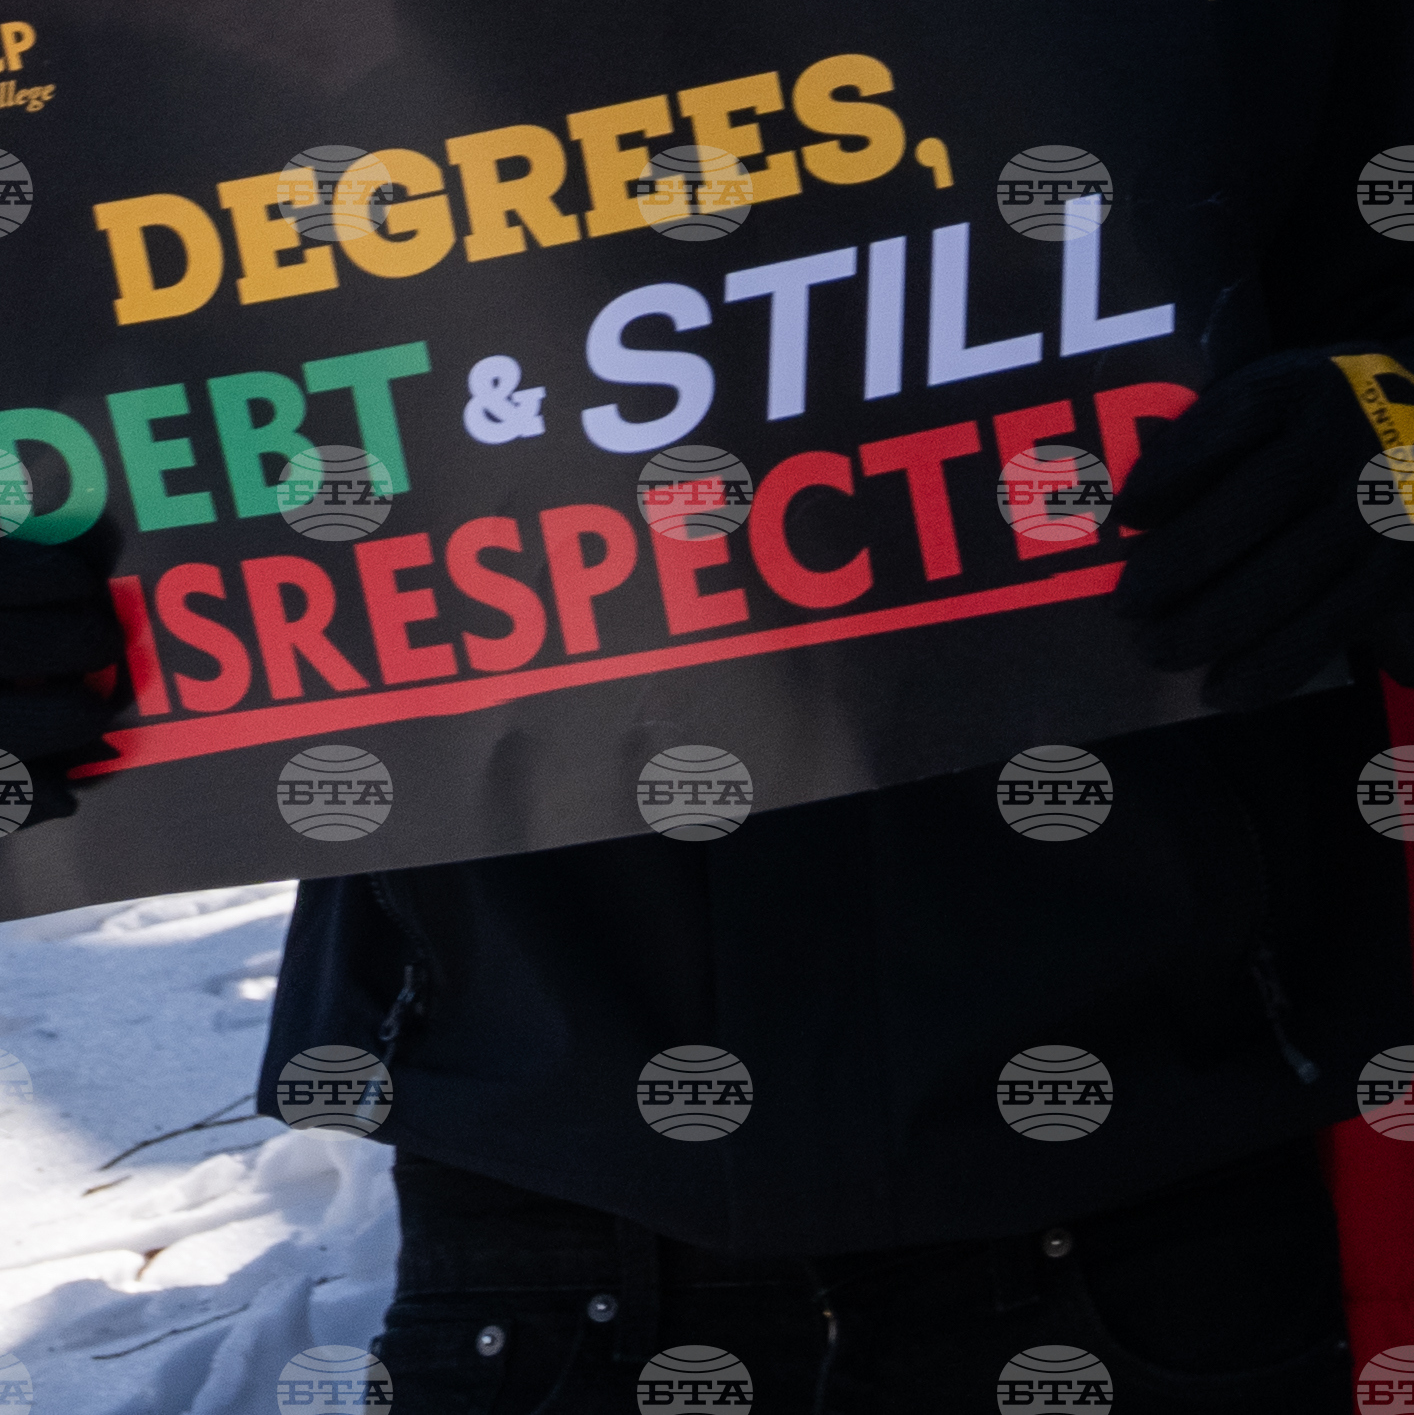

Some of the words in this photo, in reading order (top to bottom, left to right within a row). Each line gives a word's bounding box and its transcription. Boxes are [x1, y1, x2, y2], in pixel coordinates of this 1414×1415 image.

[93, 52, 954, 326] DEGREES,
[0, 340, 432, 545] DEBT
[463, 355, 547, 445] &
[581, 193, 1176, 454] STILL
[88, 380, 1202, 717] ISRESPECTED
